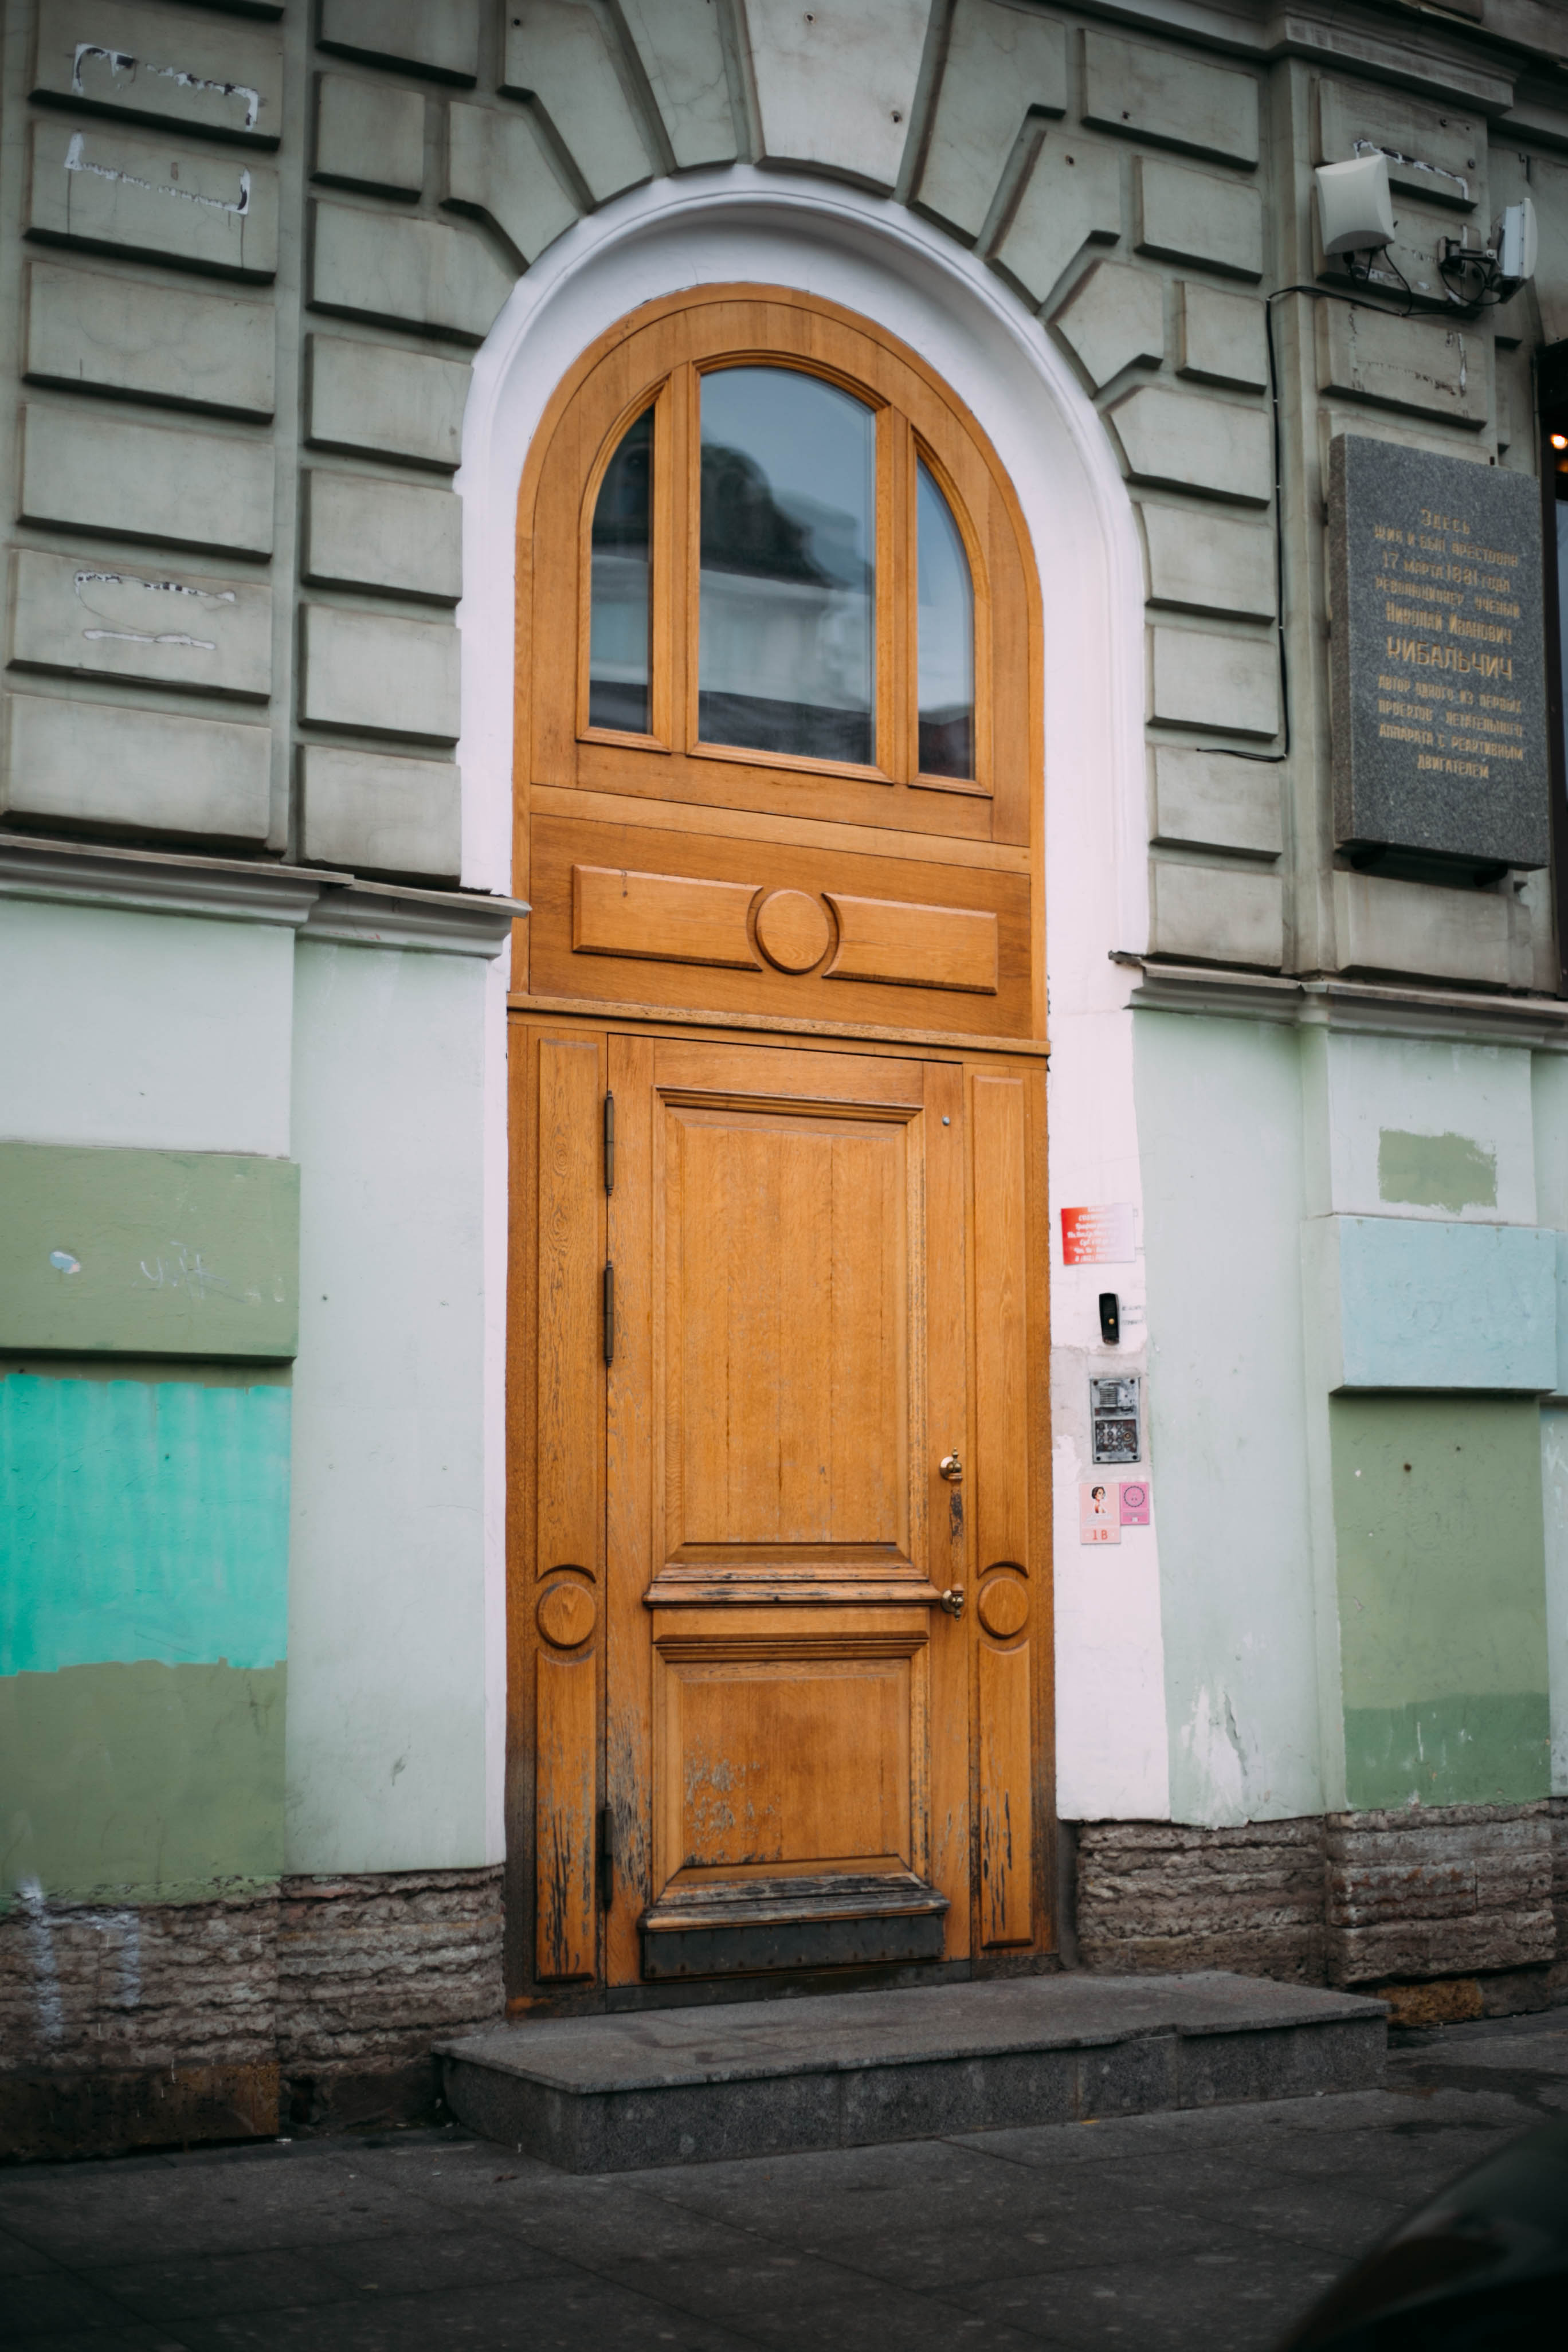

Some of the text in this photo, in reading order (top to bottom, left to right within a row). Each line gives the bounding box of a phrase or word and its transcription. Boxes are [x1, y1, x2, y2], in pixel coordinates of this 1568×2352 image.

[1421, 508, 1470, 535] ЗДЕСЬ
[1374, 526, 1518, 567] ЖИЛ И БЫЛ АРЕСТОВАН
[1375, 575, 1464, 606] РЕВОЛЮЦИОНЕР
[1383, 551, 1511, 593] 17 МАРТА 1881 ГОДА
[1386, 635, 1512, 681] КИБАЛЬЧИЧ
[1378, 674, 1522, 714] АВТОР ОДНОГО ИЗ ПЕРВЫХ
[1378, 699, 1523, 738] ПРОЕКТОВ ЛЕТАТЕЛЬНОГО
[1379, 723, 1523, 761] АППАРАТА С РЕАКТИВНЫМ
[1417, 754, 1489, 779] ДВИГАТЕЛЕМ
